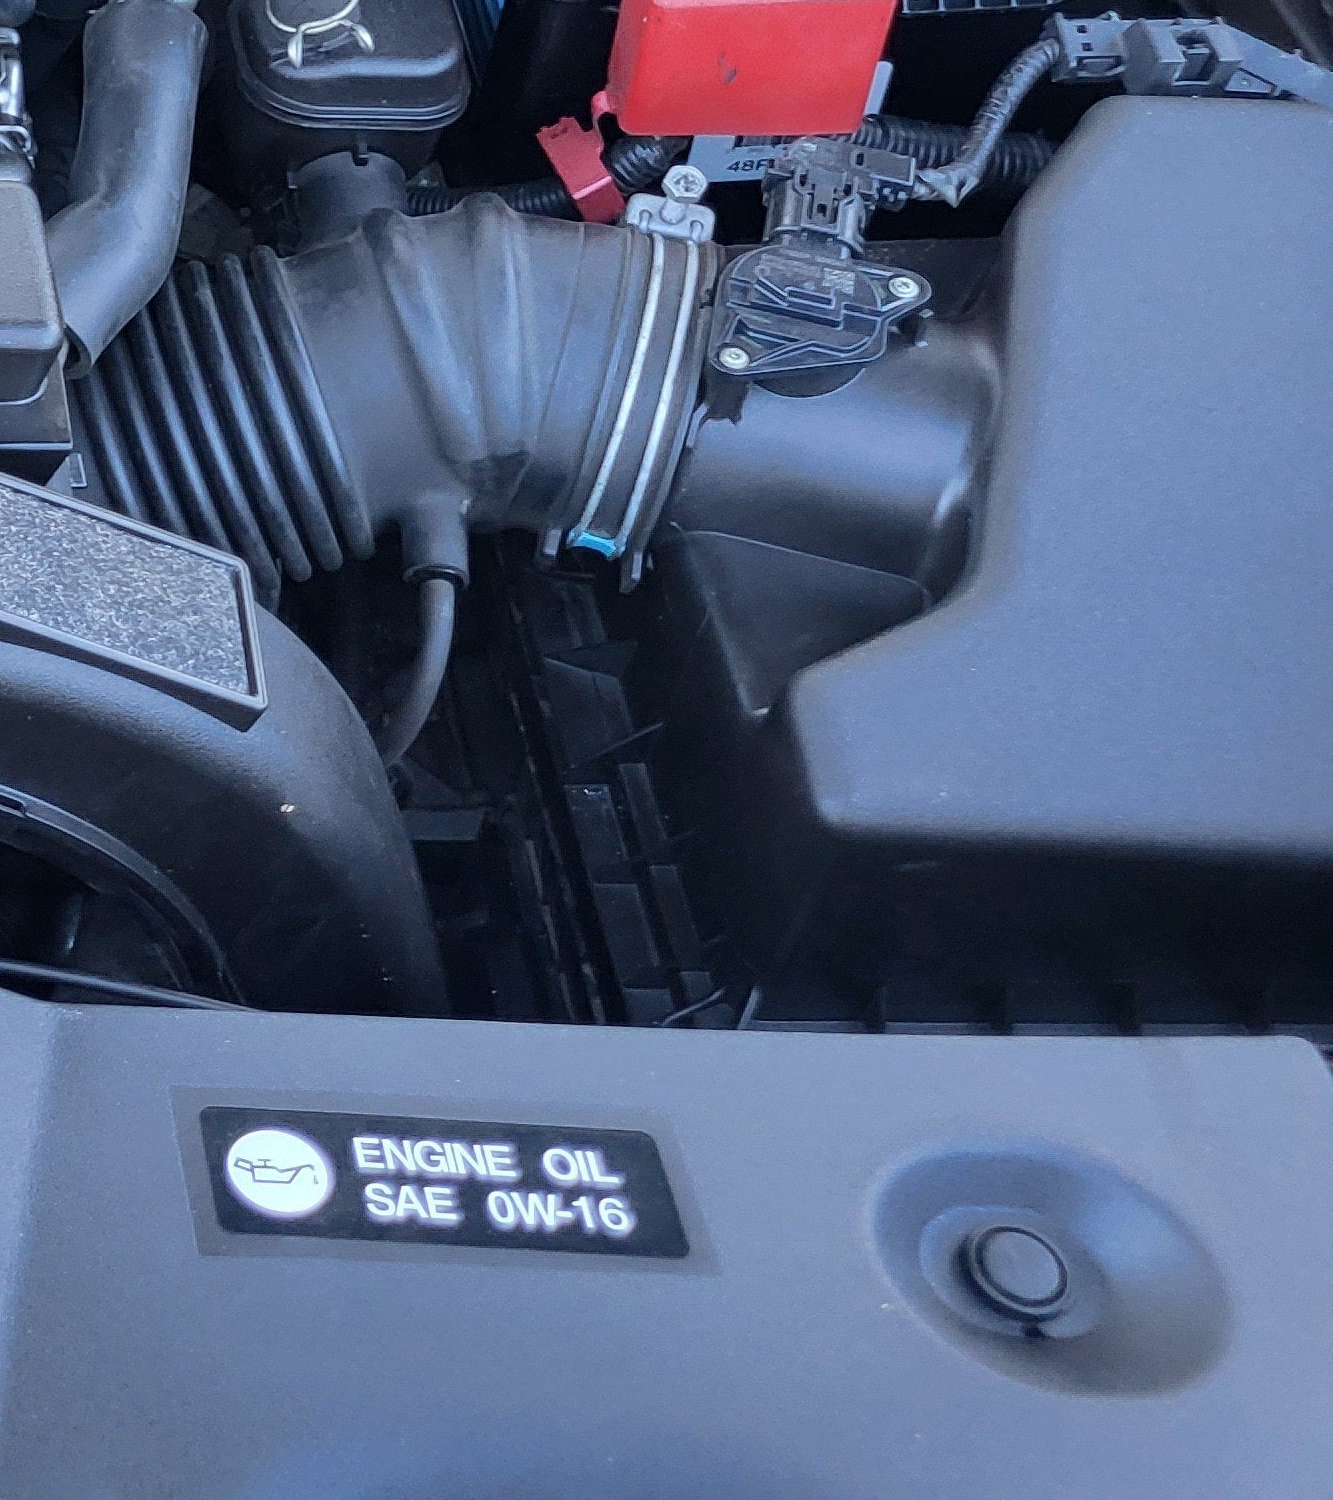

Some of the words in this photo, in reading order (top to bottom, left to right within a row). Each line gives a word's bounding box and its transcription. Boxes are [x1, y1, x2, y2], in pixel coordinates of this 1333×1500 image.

[351, 1135, 519, 1178] ENGINE
[541, 1147, 621, 1185] OIL
[364, 1182, 462, 1221] SAE
[486, 1189, 633, 1233] 0W-16
